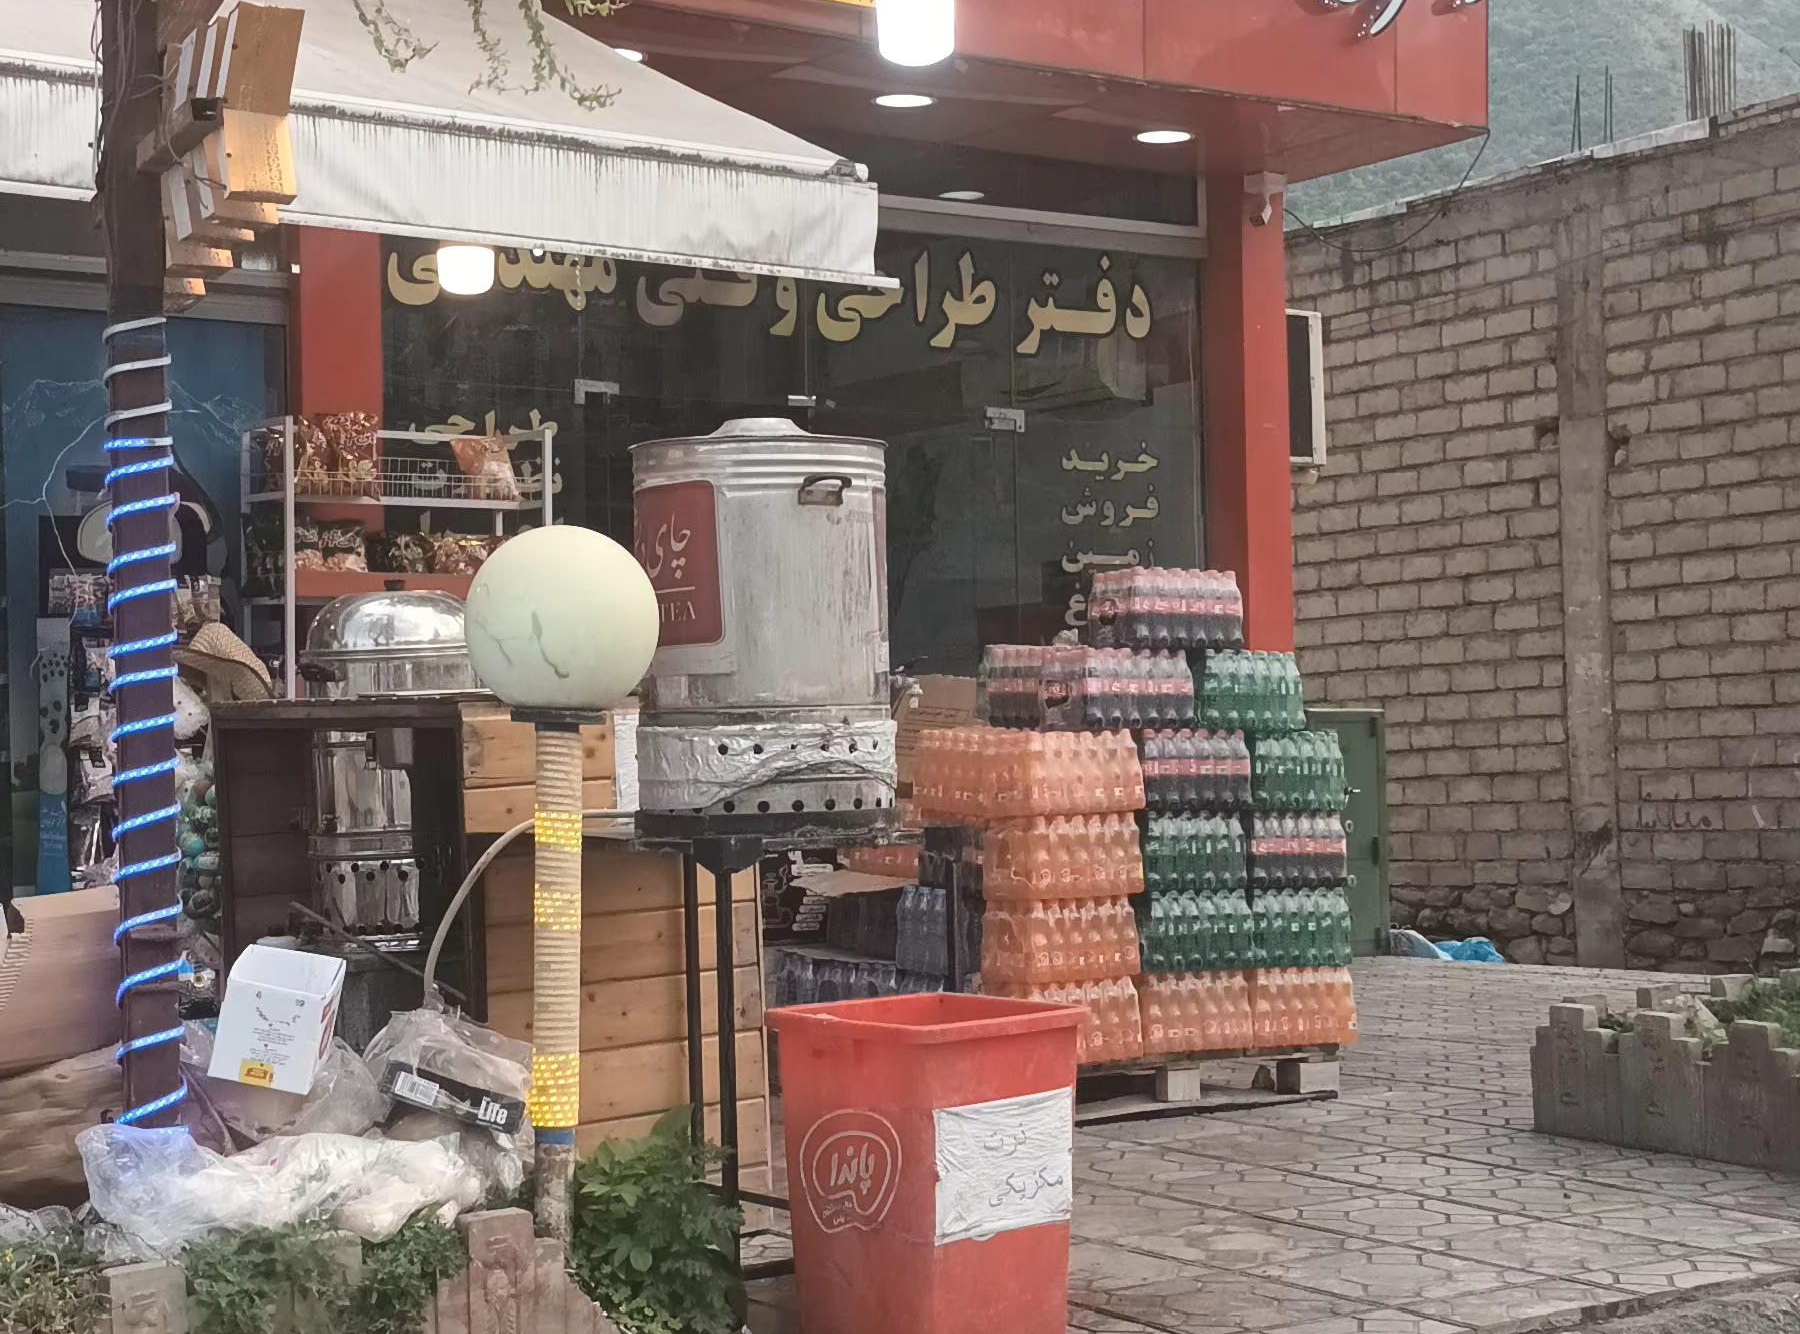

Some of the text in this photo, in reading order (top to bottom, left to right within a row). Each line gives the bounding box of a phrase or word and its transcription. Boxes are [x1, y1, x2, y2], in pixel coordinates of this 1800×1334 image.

[387, 248, 618, 312] مهندی
[816, 250, 998, 349] طراحی
[1015, 255, 1152, 355] دفتر
[1061, 441, 1159, 481] خرید
[1061, 483, 1159, 527] فروش
[646, 511, 692, 579] چای
[1061, 539, 1155, 574] زمین
[830, 1142, 875, 1195] پاندا
[988, 1166, 1064, 1208] مکزیکی
